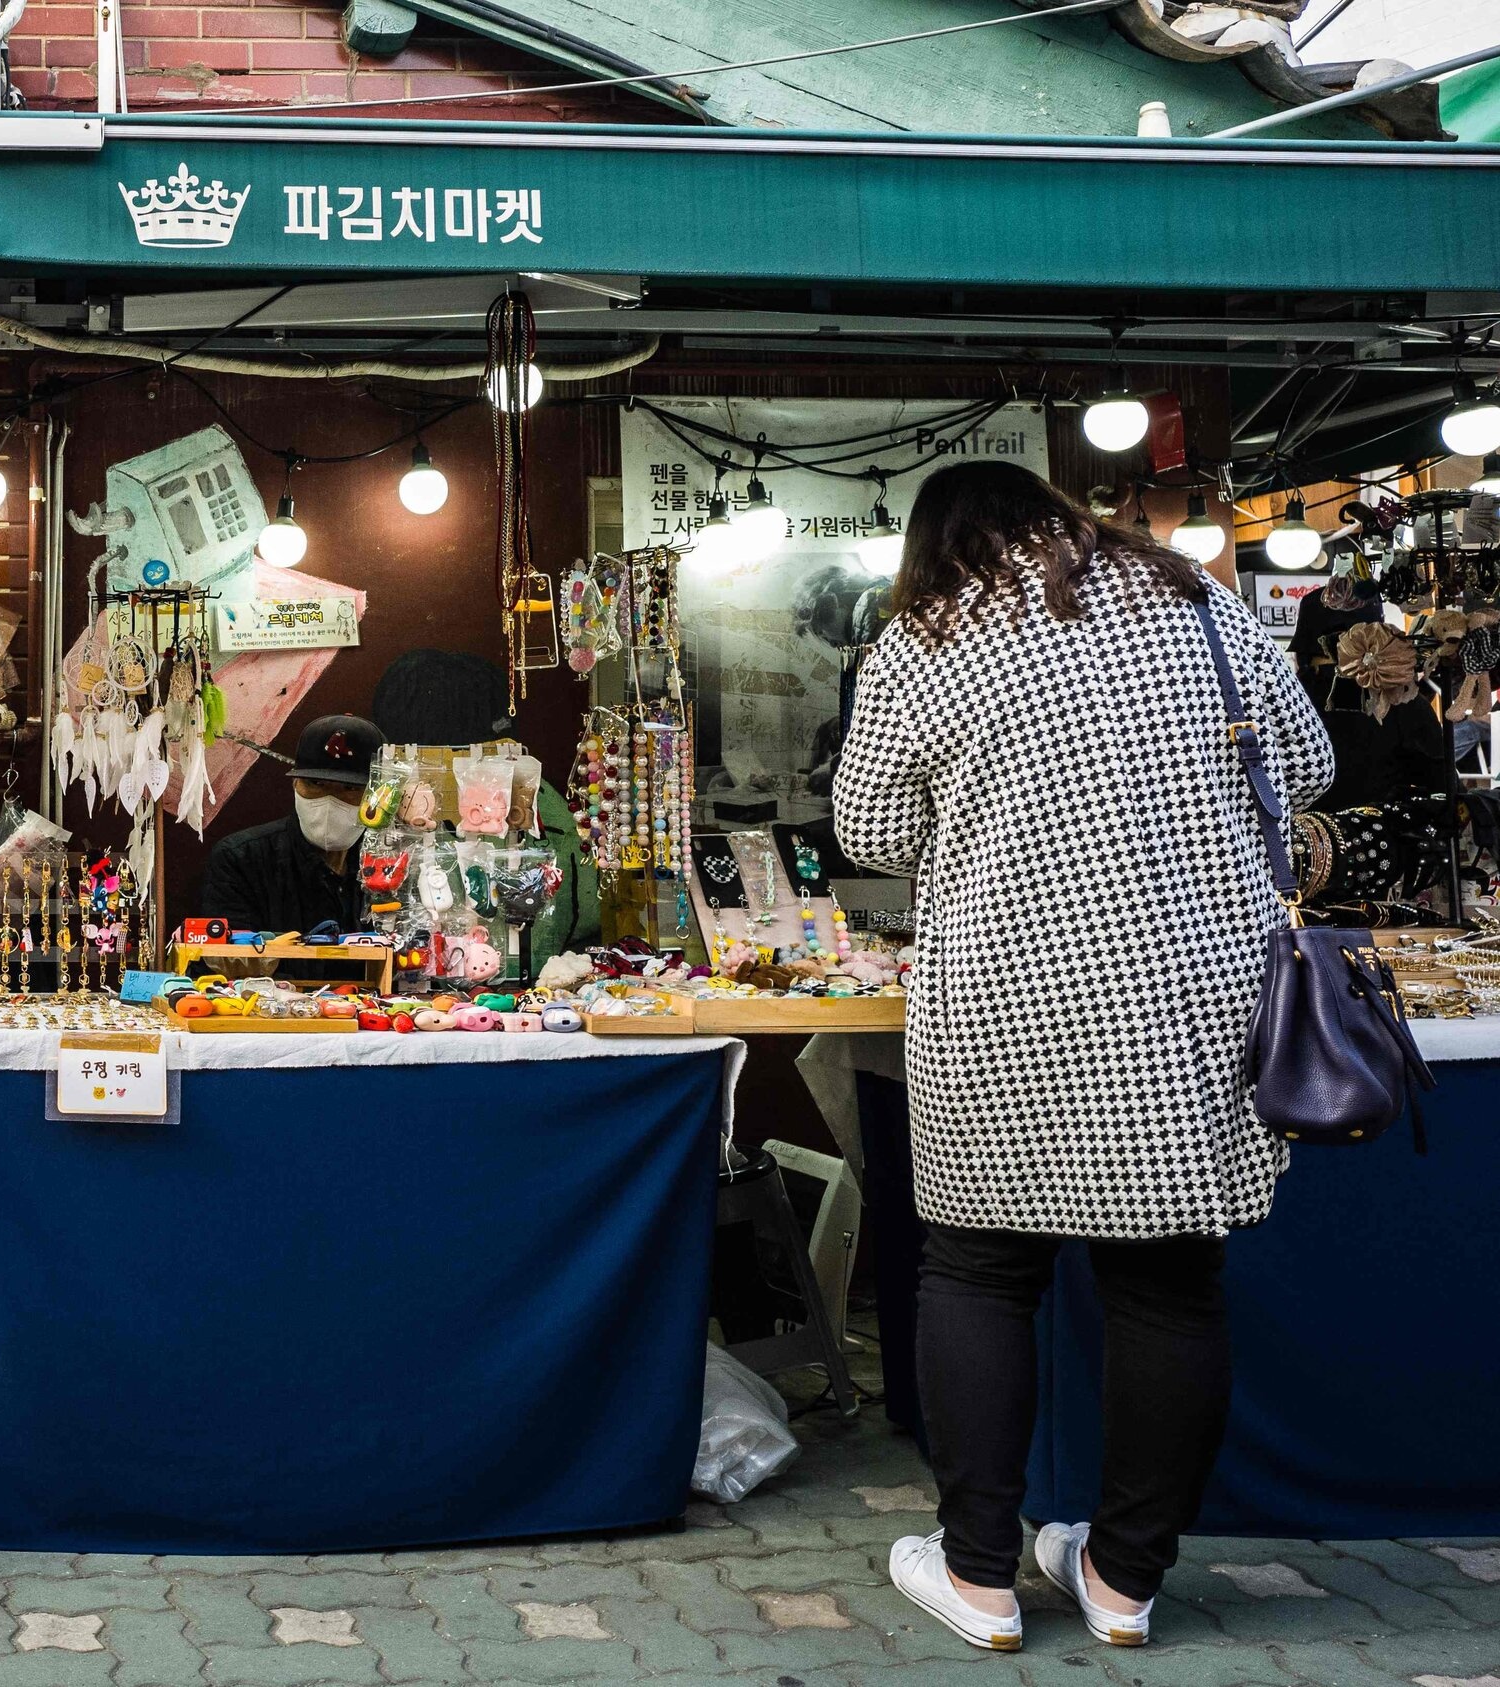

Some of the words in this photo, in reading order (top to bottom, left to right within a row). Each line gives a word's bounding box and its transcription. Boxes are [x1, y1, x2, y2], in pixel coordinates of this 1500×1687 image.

[283, 185, 543, 244] 파김치마켓
[917, 428, 1025, 454] PenTrail
[650, 463, 688, 485] 펜을
[651, 490, 688, 511] 선물
[651, 518, 669, 534] 그
[268, 611, 323, 628] 드림캐쳐
[81, 1061, 107, 1079] 우정
[116, 1062, 141, 1078] 키링
